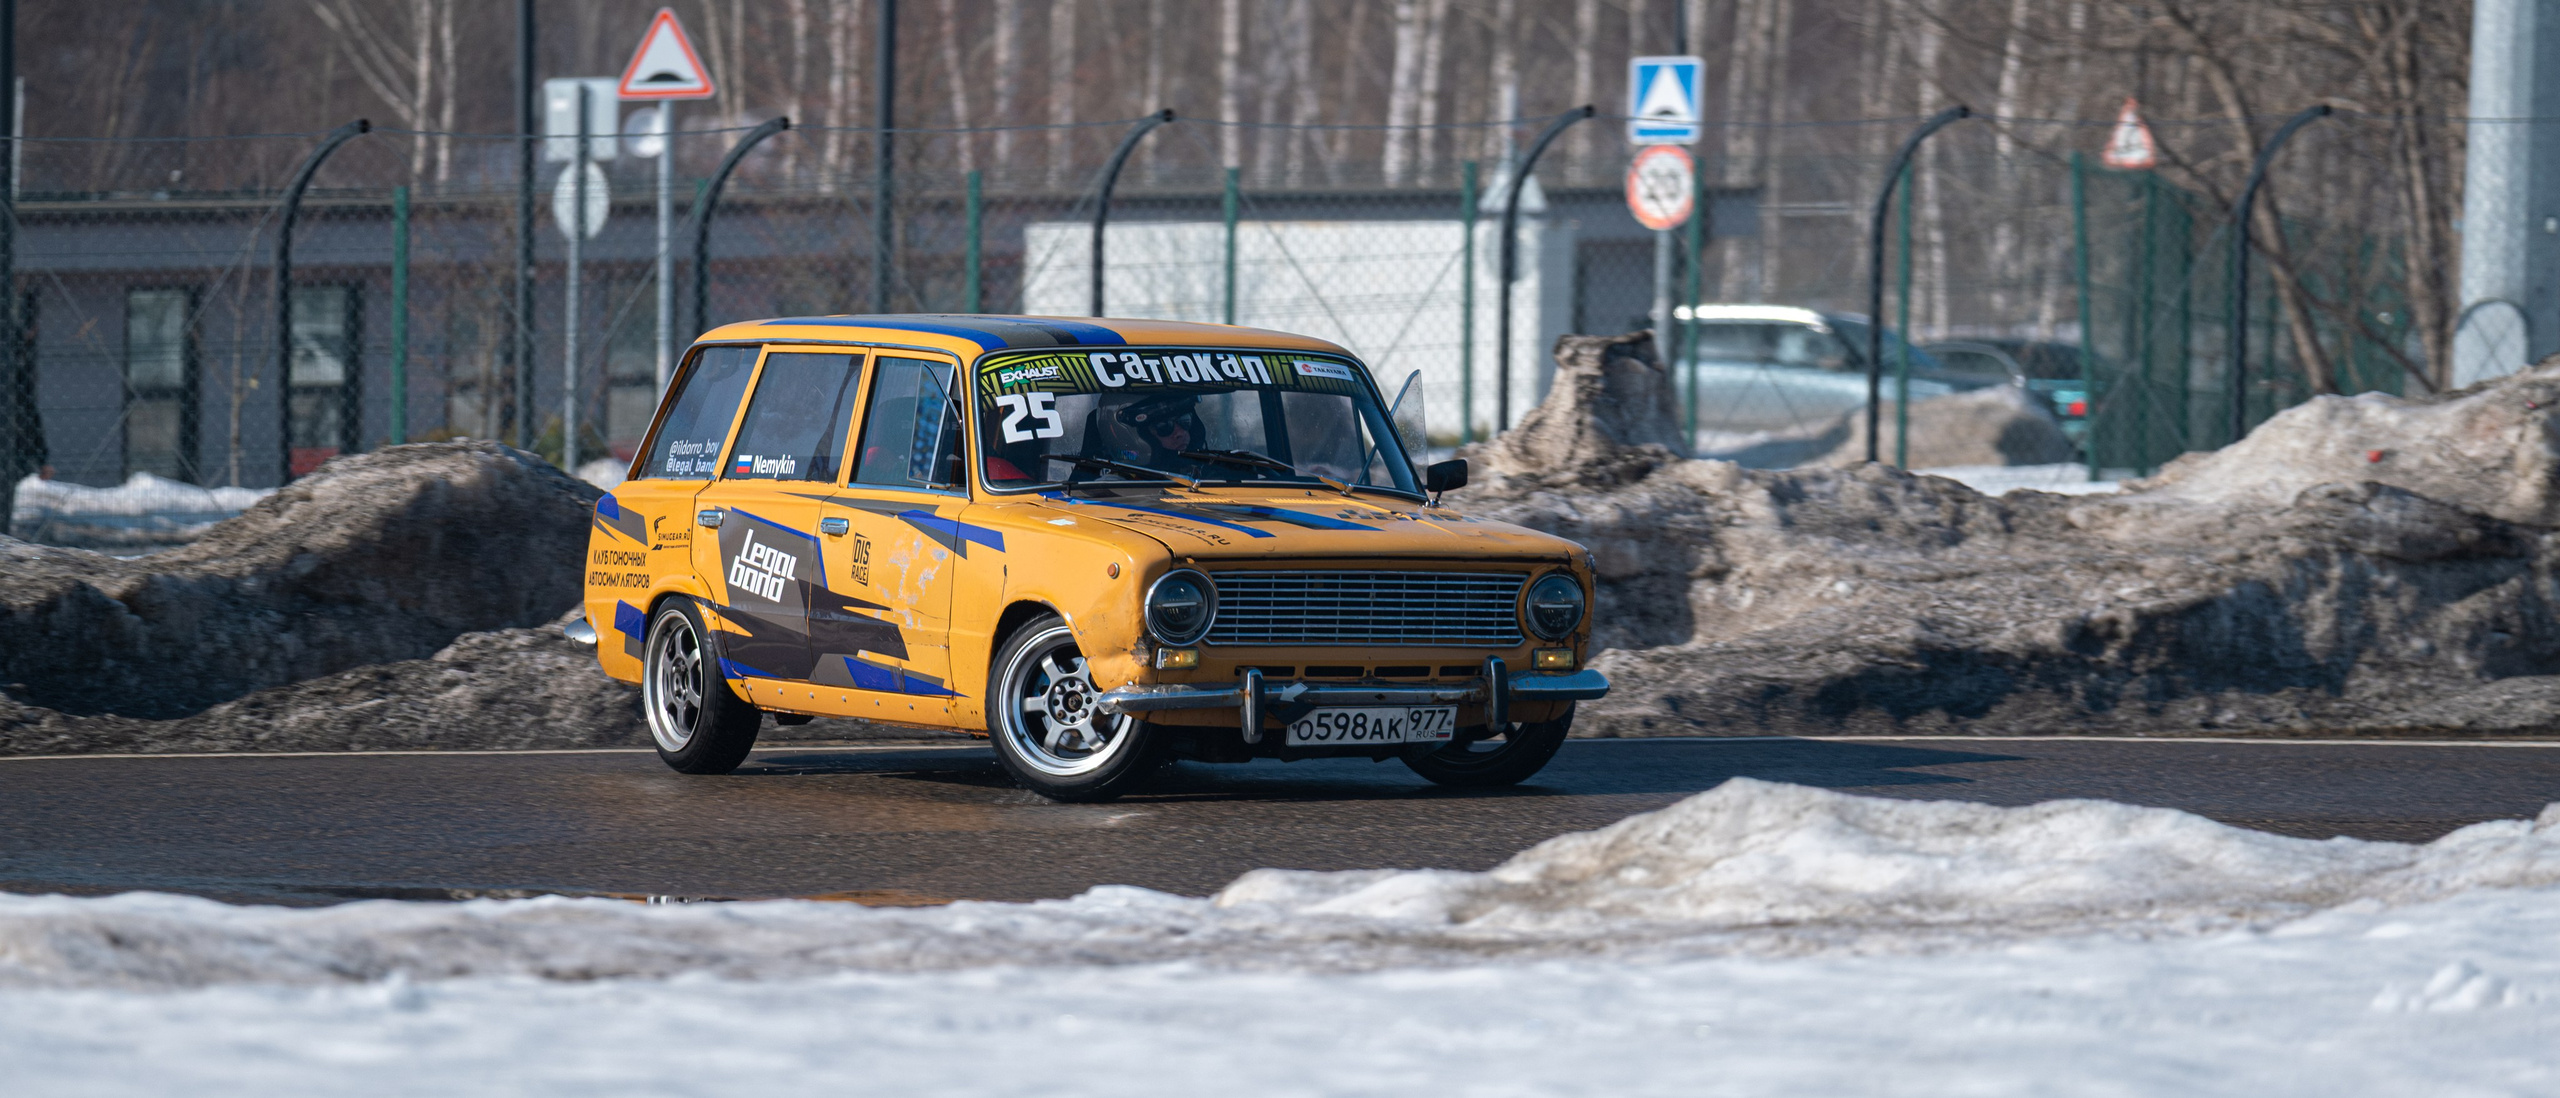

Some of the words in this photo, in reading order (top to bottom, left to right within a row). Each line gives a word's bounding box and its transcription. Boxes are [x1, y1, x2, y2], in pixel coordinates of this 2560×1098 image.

[1000, 365, 1059, 385] EXHAUST
[1313, 366, 1347, 376] TAKAYAMA
[995, 392, 1064, 444] 25
[669, 438, 720, 458] @ildorro_boy
[666, 457, 717, 475] @legal_band
[752, 454, 796, 478] Nemykin
[593, 549, 609, 566] КЛУБ
[609, 550, 647, 567] ГОНОЧНЫХ
[853, 539, 871, 565] DIS
[588, 571, 650, 589] АВТОСИМУЛЯТОРОВ
[851, 564, 867, 581] RACE
[1409, 709, 1450, 731] 977
[1415, 730, 1436, 738] RUS
